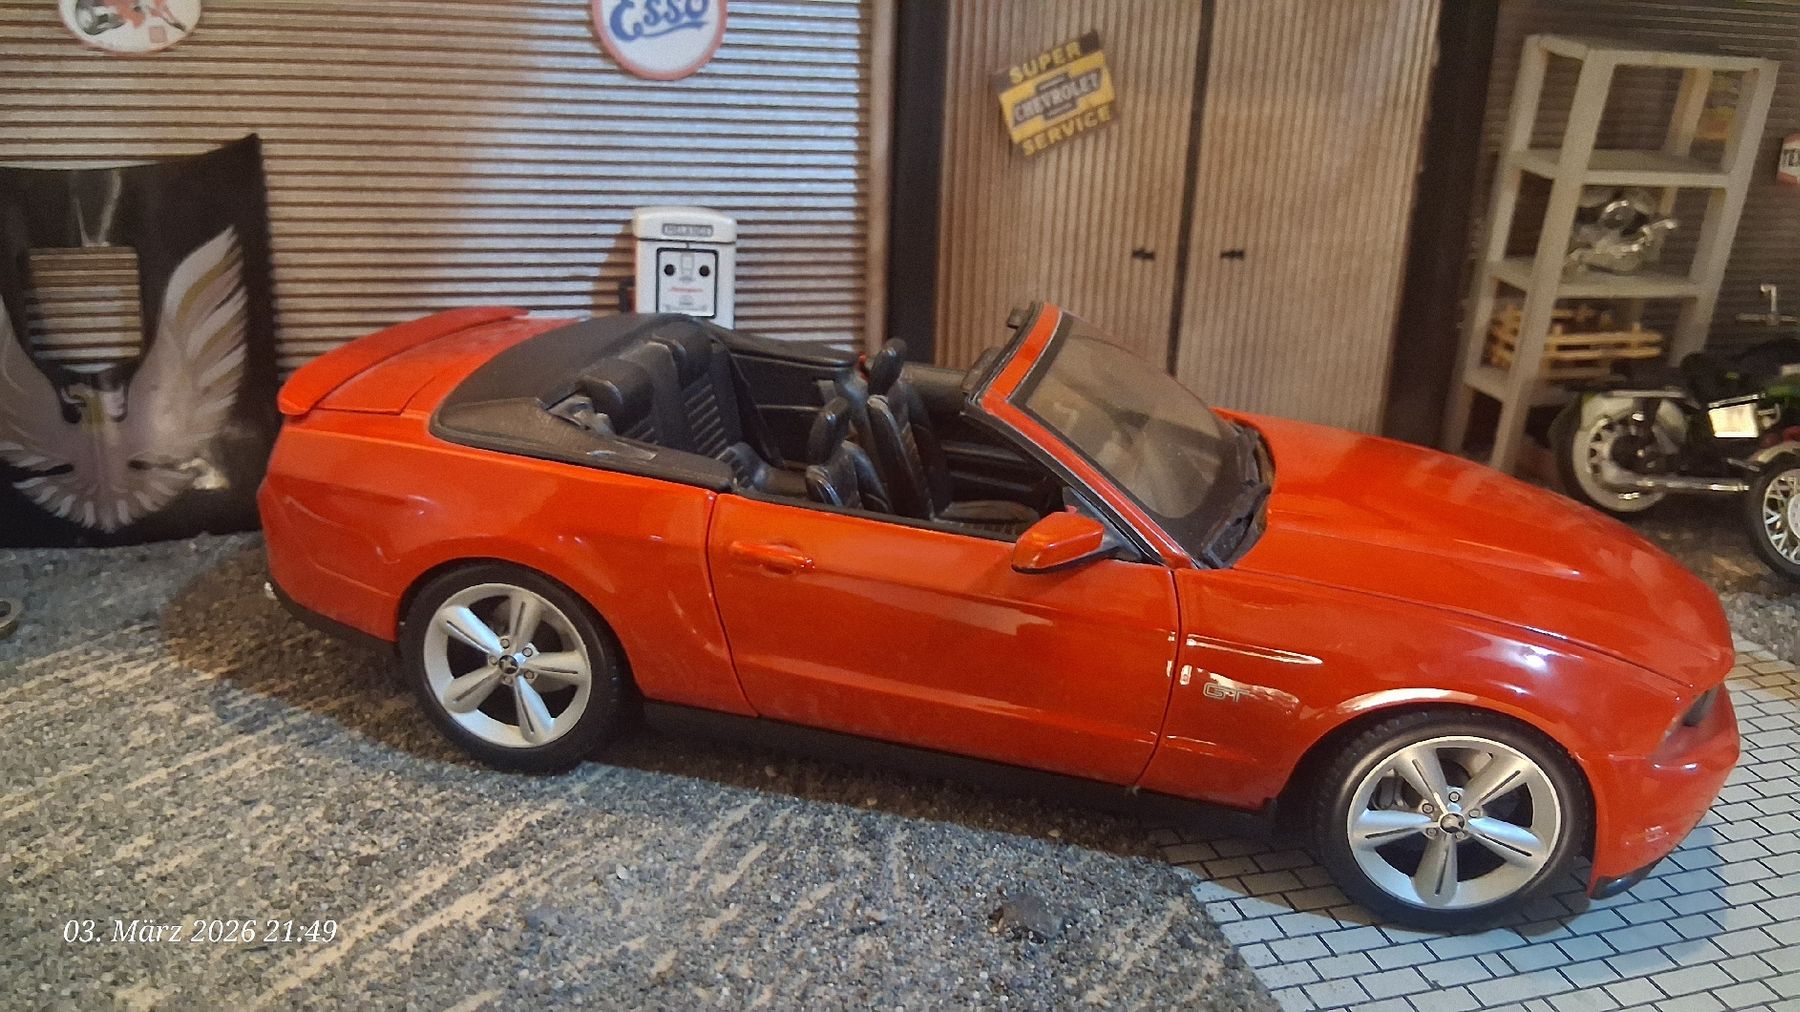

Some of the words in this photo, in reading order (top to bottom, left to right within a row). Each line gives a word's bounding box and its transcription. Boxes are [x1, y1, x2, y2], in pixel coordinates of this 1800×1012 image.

[1009, 41, 1081, 84] SUPER
[1014, 71, 1099, 122] CHEVROLET
[1022, 104, 1110, 156] SERVICE
[1204, 682, 1250, 702] GT
